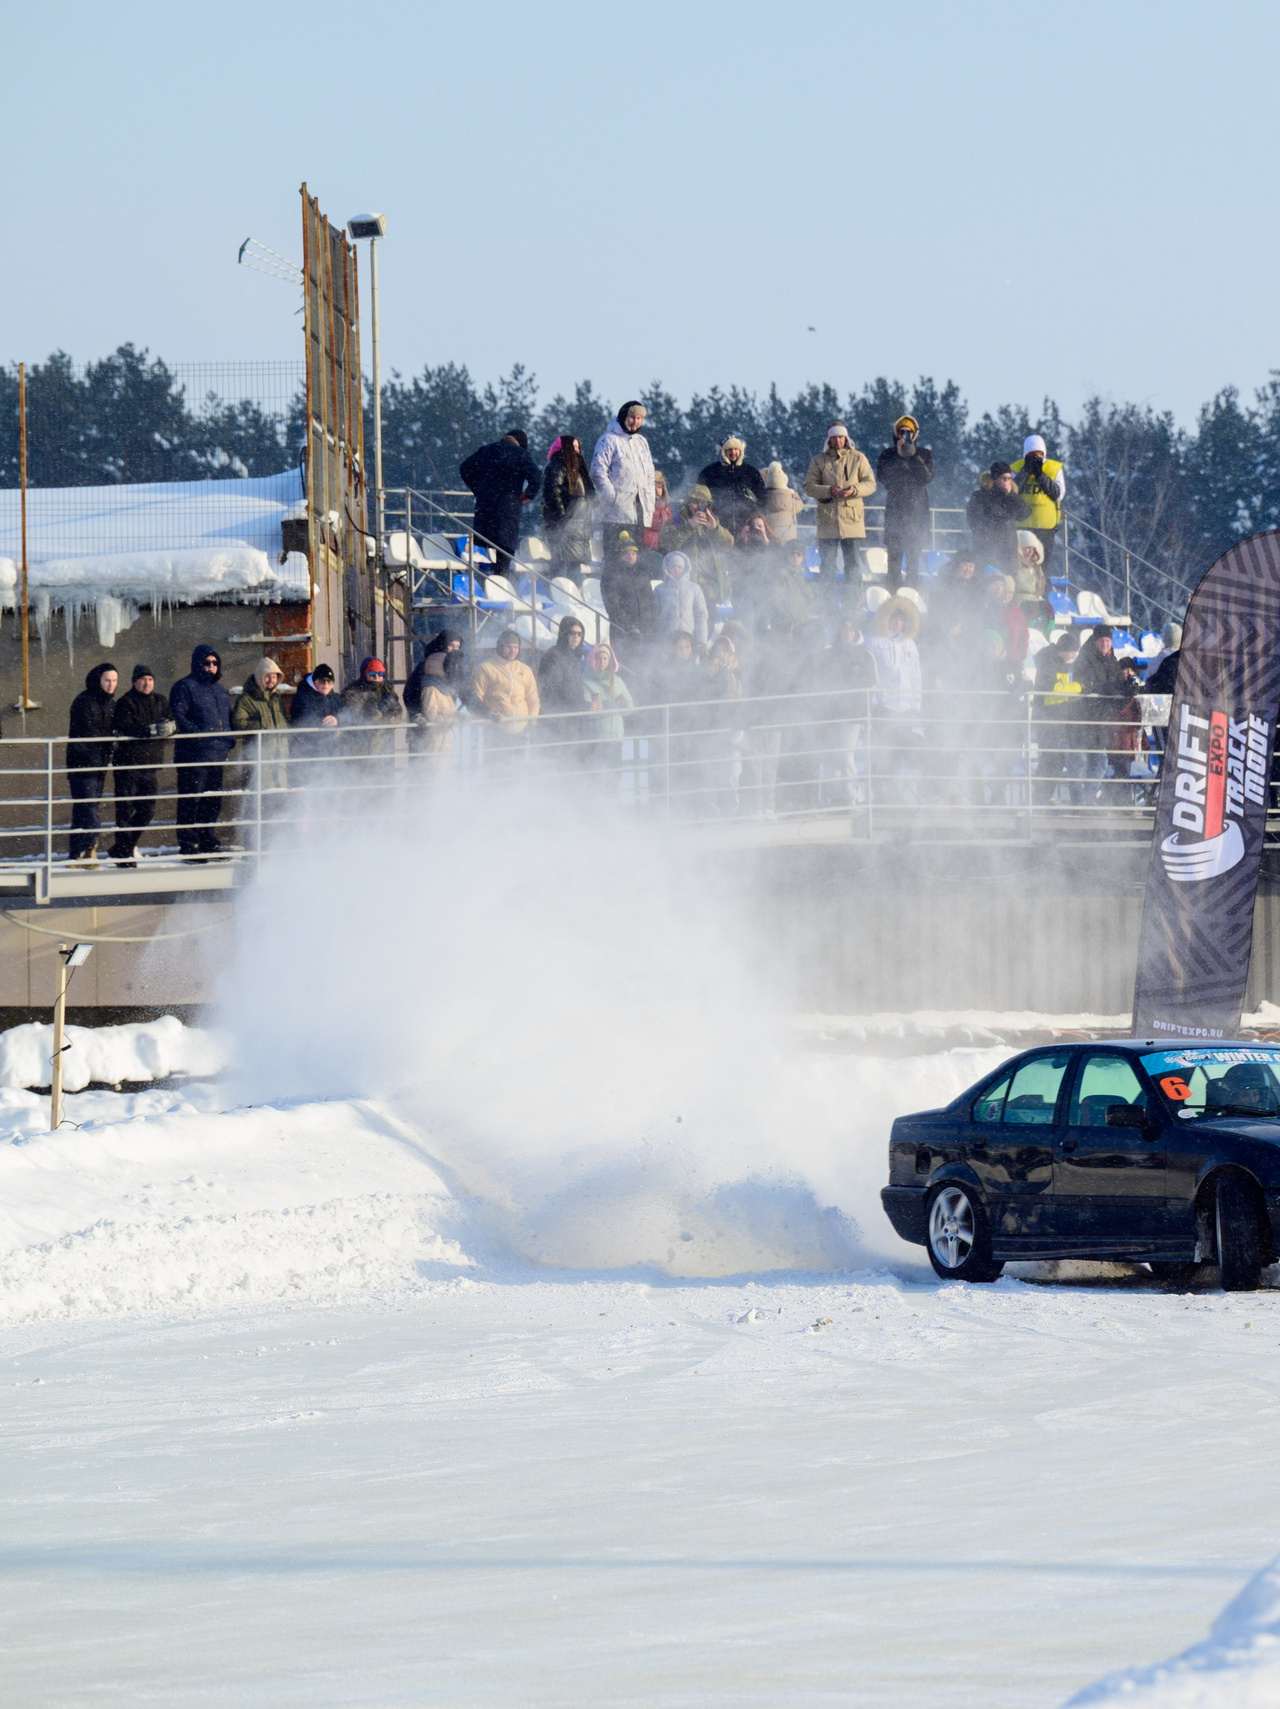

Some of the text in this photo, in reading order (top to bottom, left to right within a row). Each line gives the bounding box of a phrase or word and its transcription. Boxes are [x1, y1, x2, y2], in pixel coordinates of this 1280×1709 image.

[1172, 703, 1210, 833] DRIFT
[1210, 724, 1225, 776] EXPO
[1225, 716, 1249, 818] TRACK
[1243, 713, 1269, 806] MODE
[1152, 1020, 1224, 1038] DRIFTEXPO.RU
[1213, 1051, 1273, 1063] WINTER
[1159, 1076, 1193, 1101] 6
